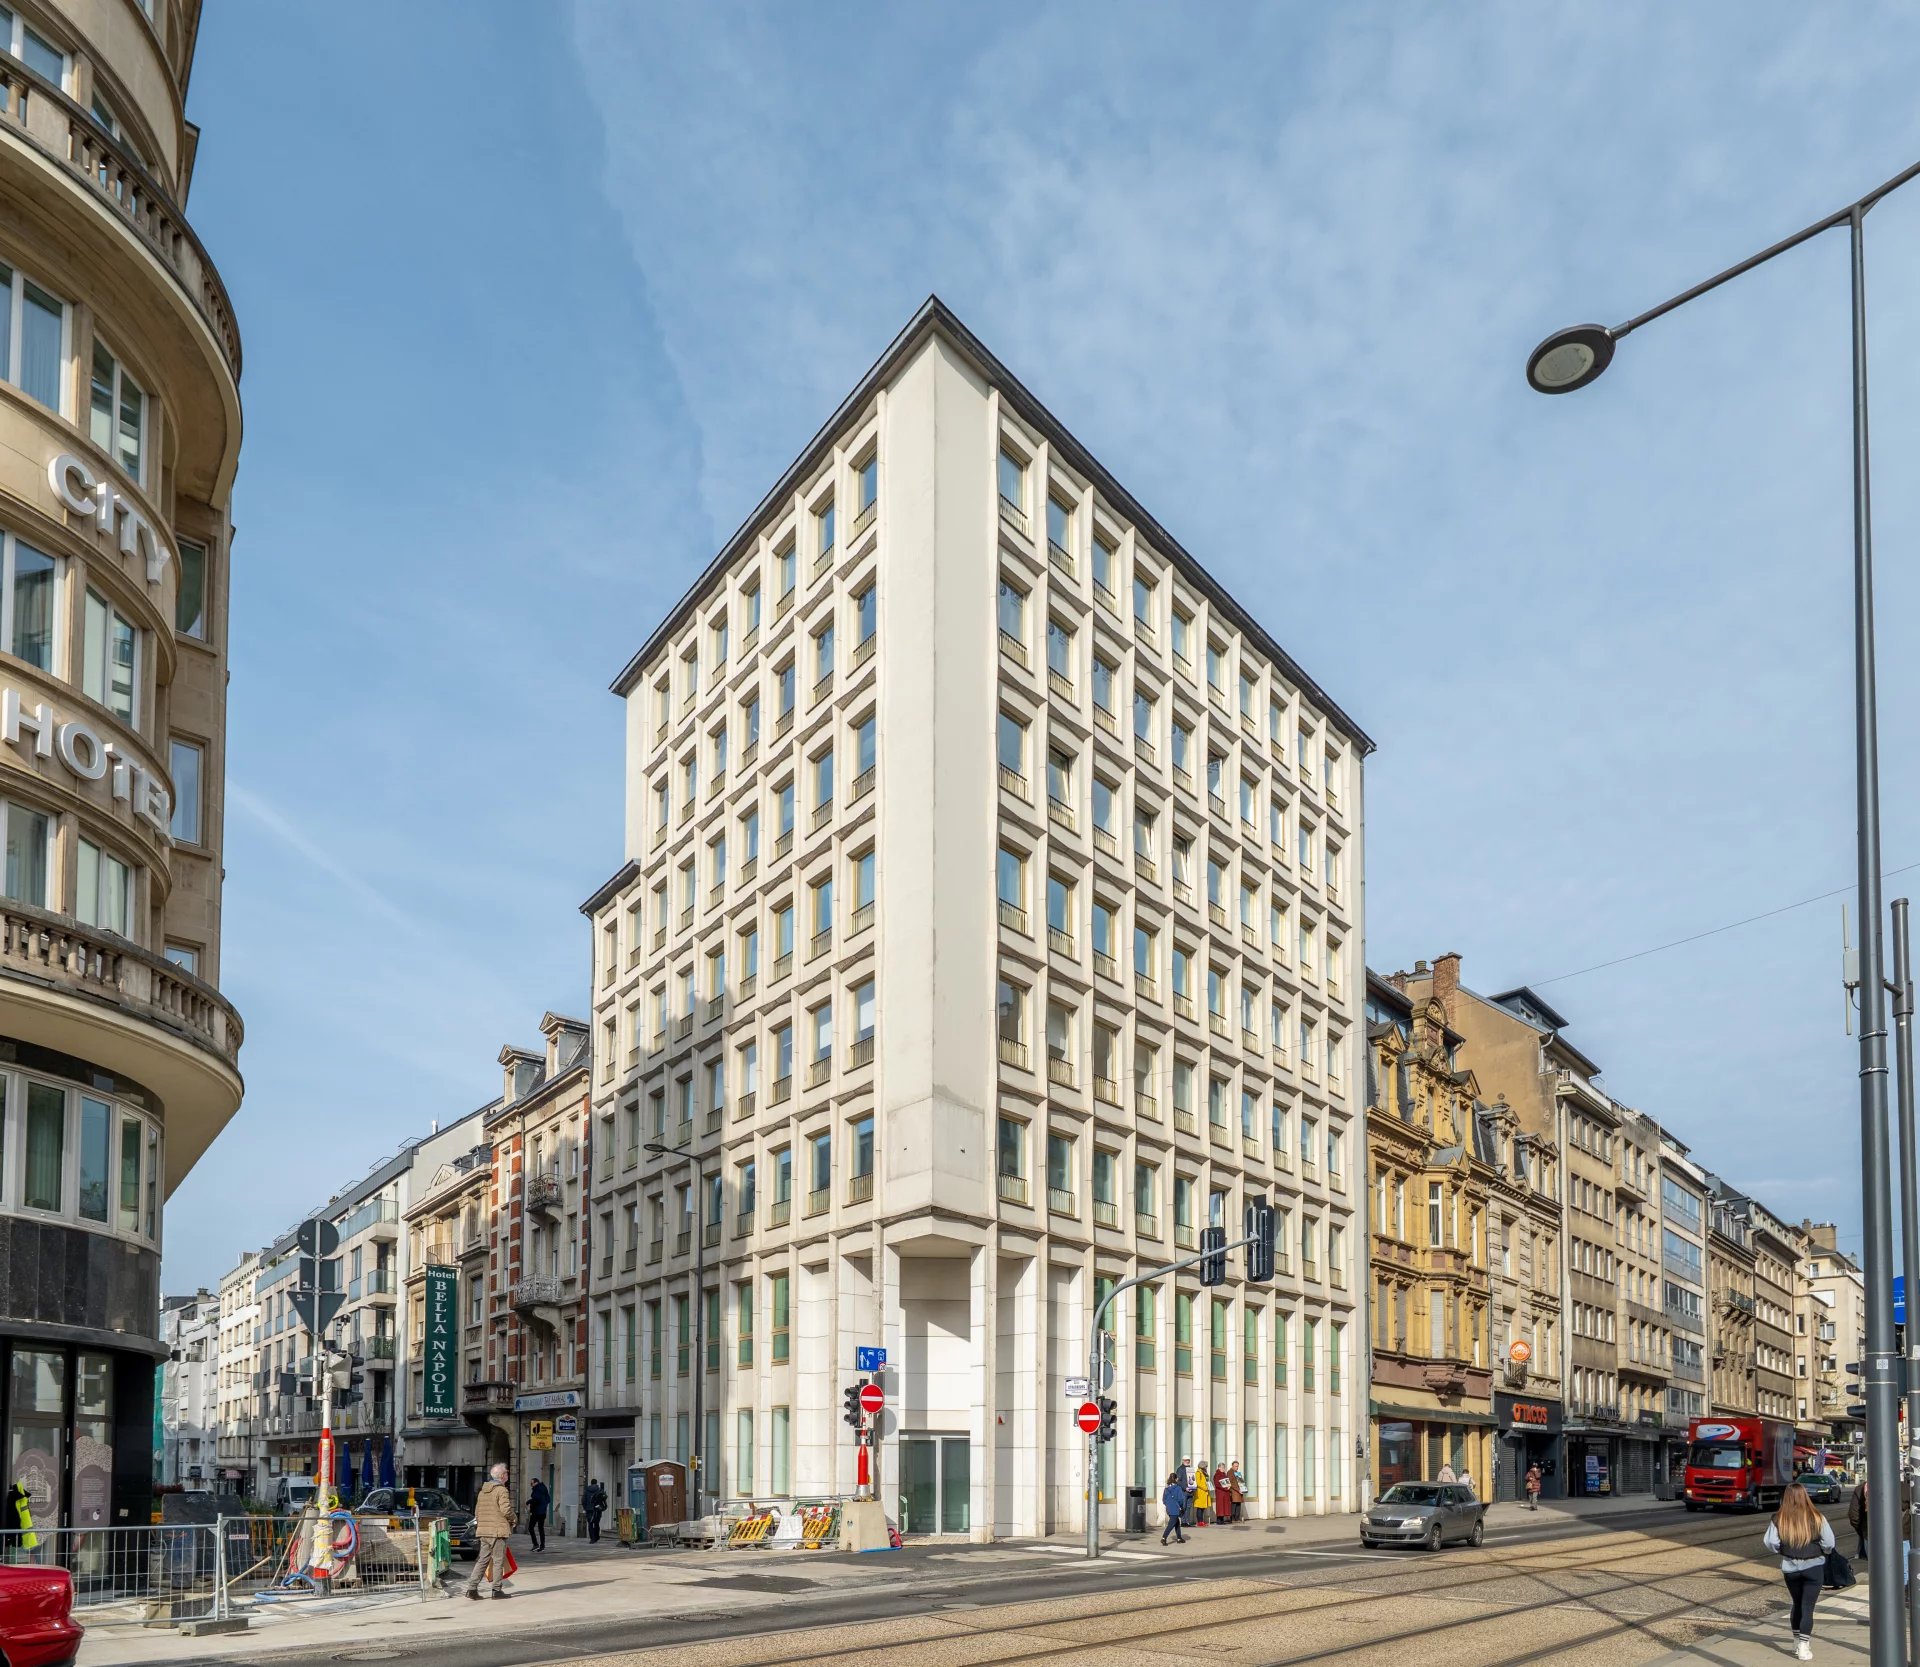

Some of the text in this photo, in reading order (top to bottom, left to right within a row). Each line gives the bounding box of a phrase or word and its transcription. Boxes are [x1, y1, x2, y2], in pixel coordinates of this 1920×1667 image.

[48, 453, 172, 585] CITY
[1, 688, 175, 848] HOTEL
[428, 1270, 455, 1279] Hotel
[431, 1280, 447, 1404] BELLA NAPOLI
[425, 1406, 453, 1414] Hotel
[1513, 1402, 1548, 1424] O'TACOS
